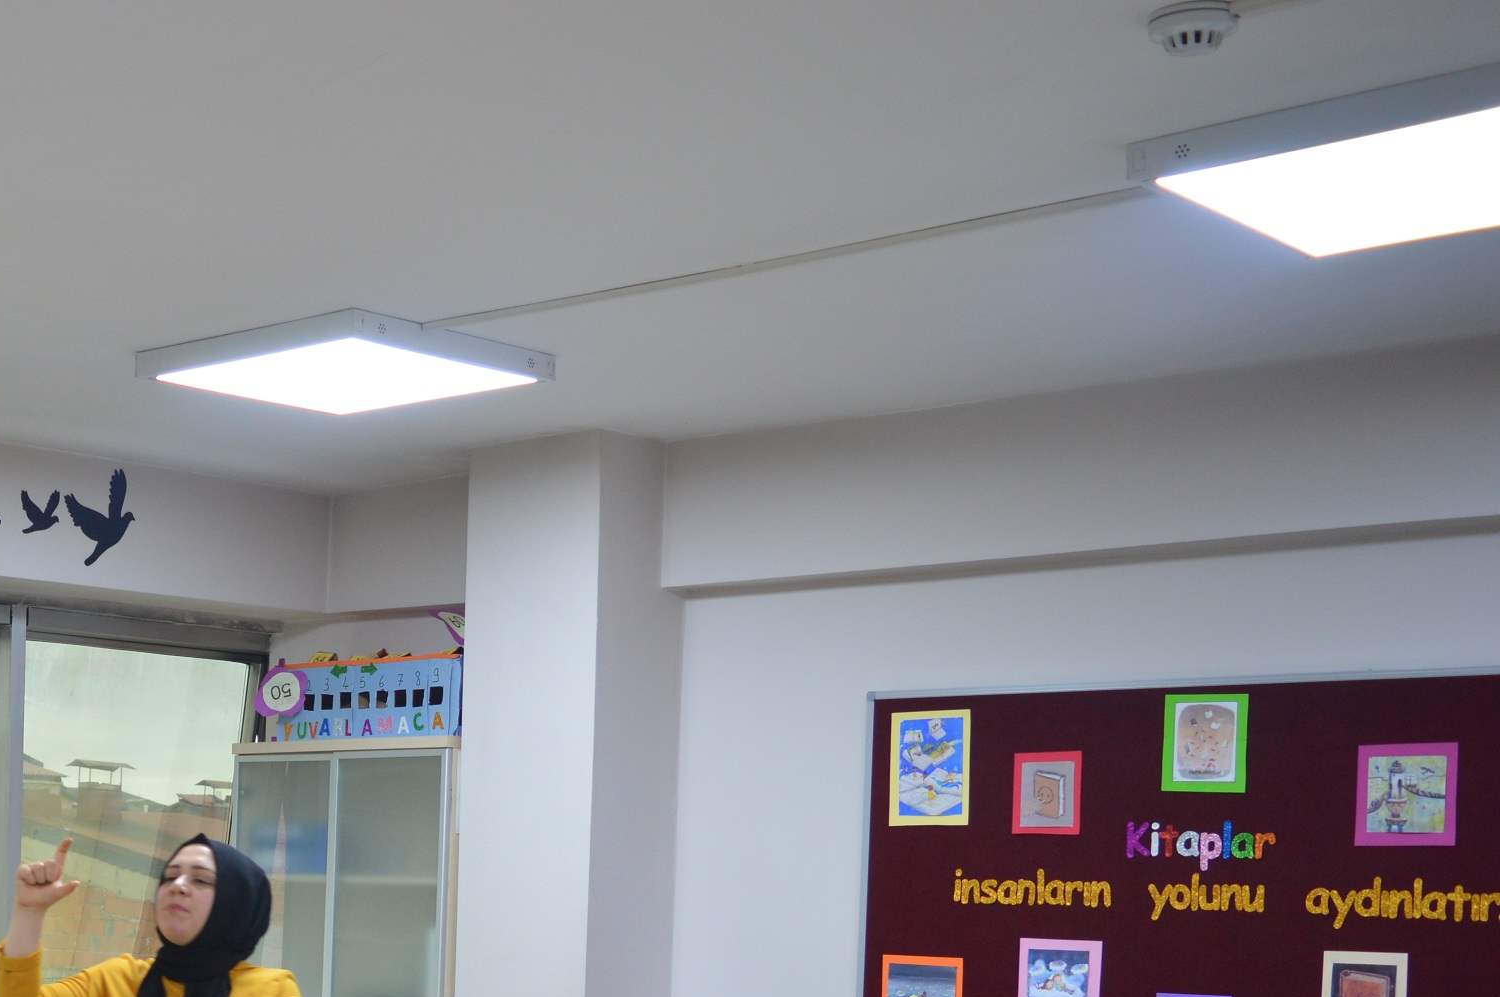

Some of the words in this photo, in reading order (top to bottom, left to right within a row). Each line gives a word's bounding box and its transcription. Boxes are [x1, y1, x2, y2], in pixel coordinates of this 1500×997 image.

[1126, 819, 1277, 871] Kitaplar
[953, 869, 1112, 908] insanların
[1148, 872, 1265, 921] yolunu
